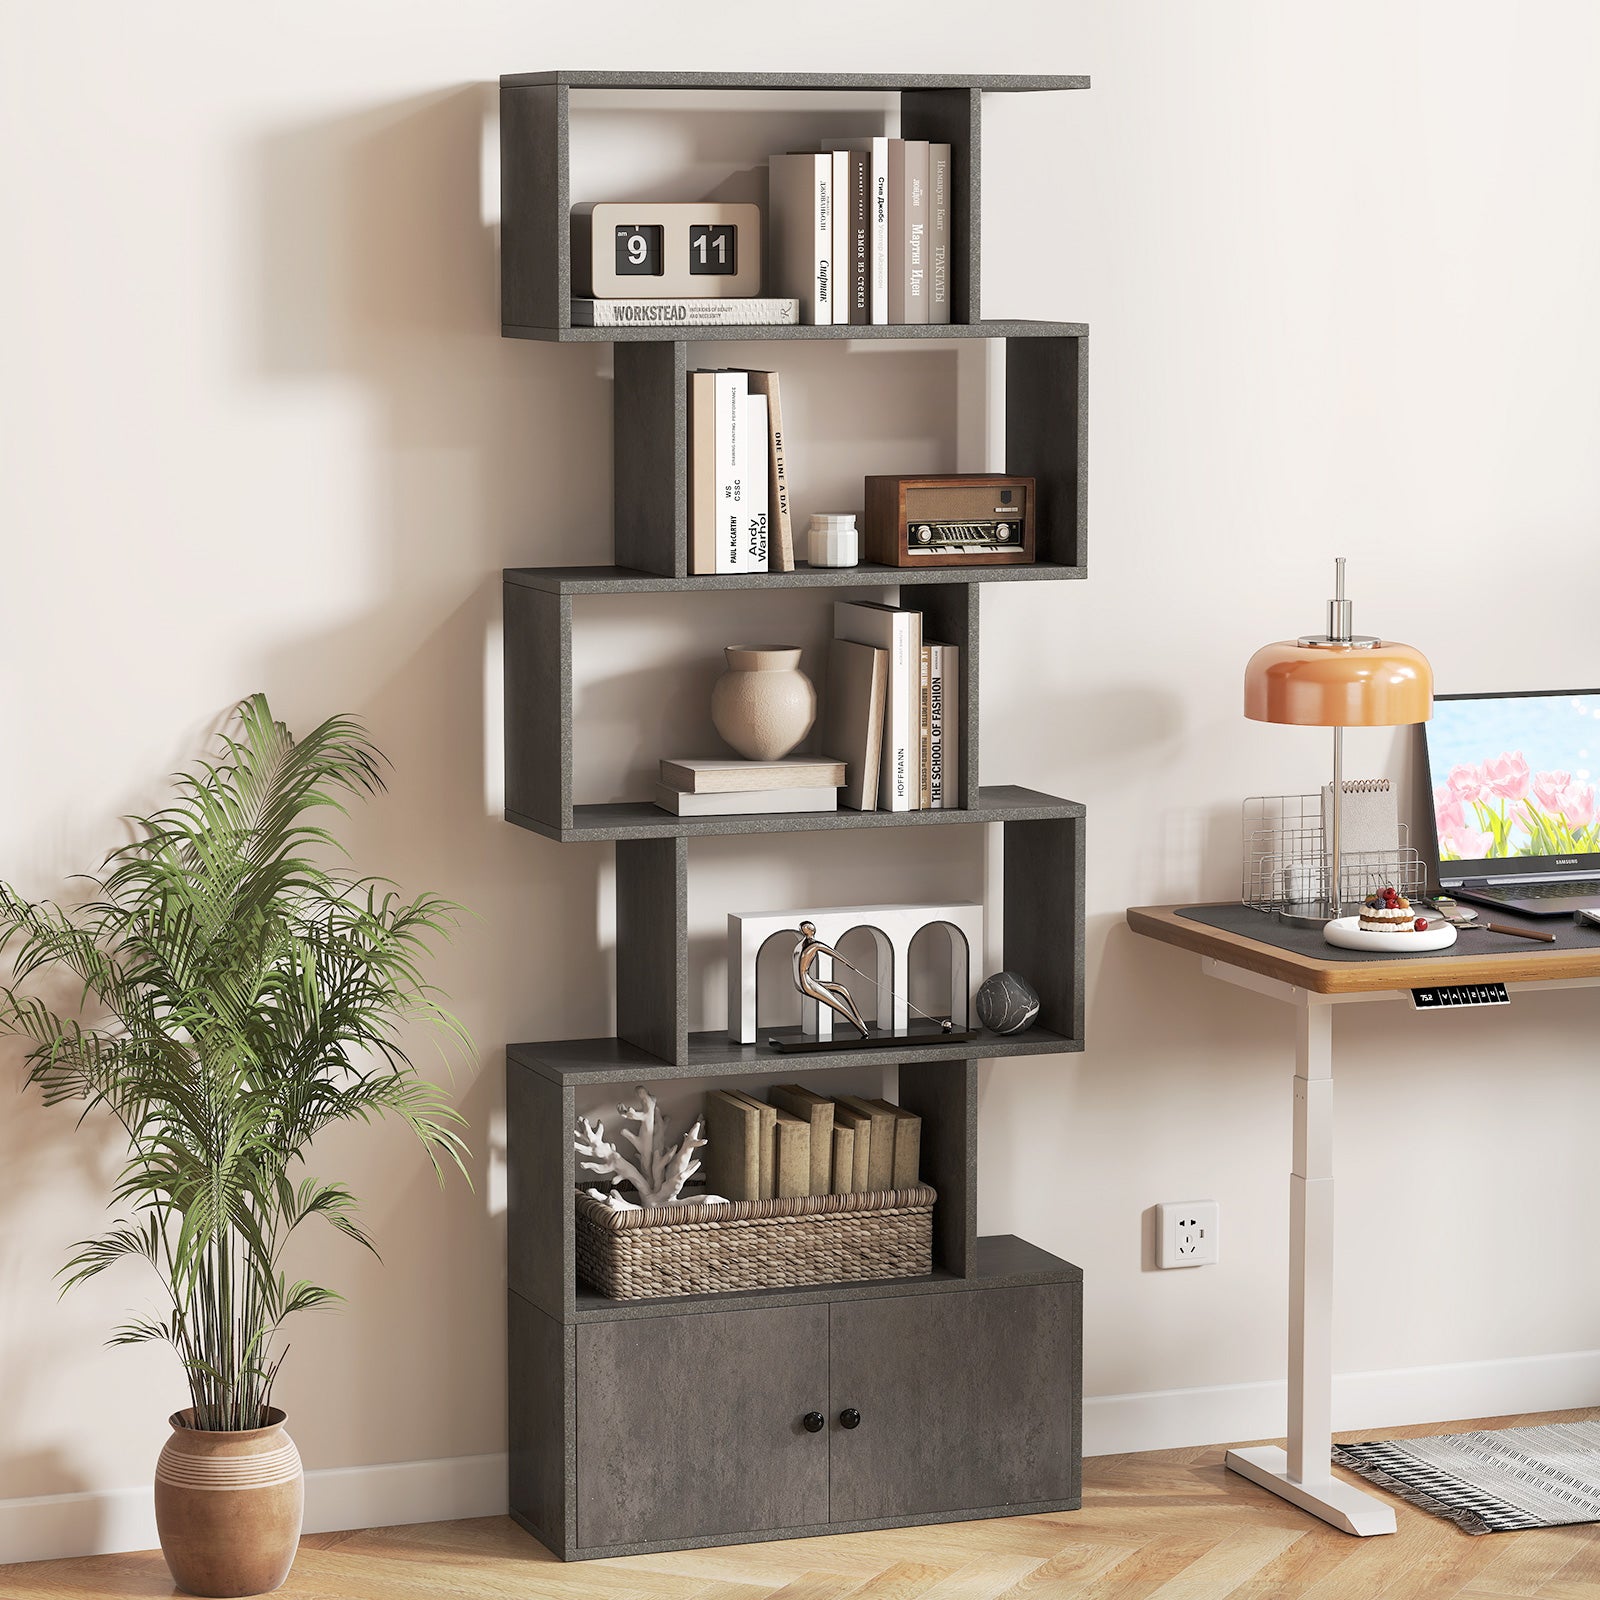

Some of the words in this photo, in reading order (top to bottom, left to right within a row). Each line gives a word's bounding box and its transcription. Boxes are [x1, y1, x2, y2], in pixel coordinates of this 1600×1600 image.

[877, 196, 885, 223] Джобс
[937, 208, 945, 231] Кант
[627, 235, 648, 265] 9
[693, 234, 726, 264] 11
[910, 224, 923, 265] Мартин
[817, 260, 830, 303] Спартак
[910, 269, 923, 297] Иден
[935, 245, 945, 303] ТРАКТАТЫ
[613, 305, 687, 321] WORKSTEAD
[774, 432, 783, 453] ONE
[777, 457, 785, 480] LINE
[725, 485, 732, 498] WS
[779, 495, 788, 515] DAY
[748, 519, 760, 556] Andy
[758, 513, 766, 562] Warhol
[931, 677, 942, 721] FASHION
[931, 723, 942, 737] OF
[931, 739, 942, 780] SCHOOL
[931, 782, 942, 802] THE
